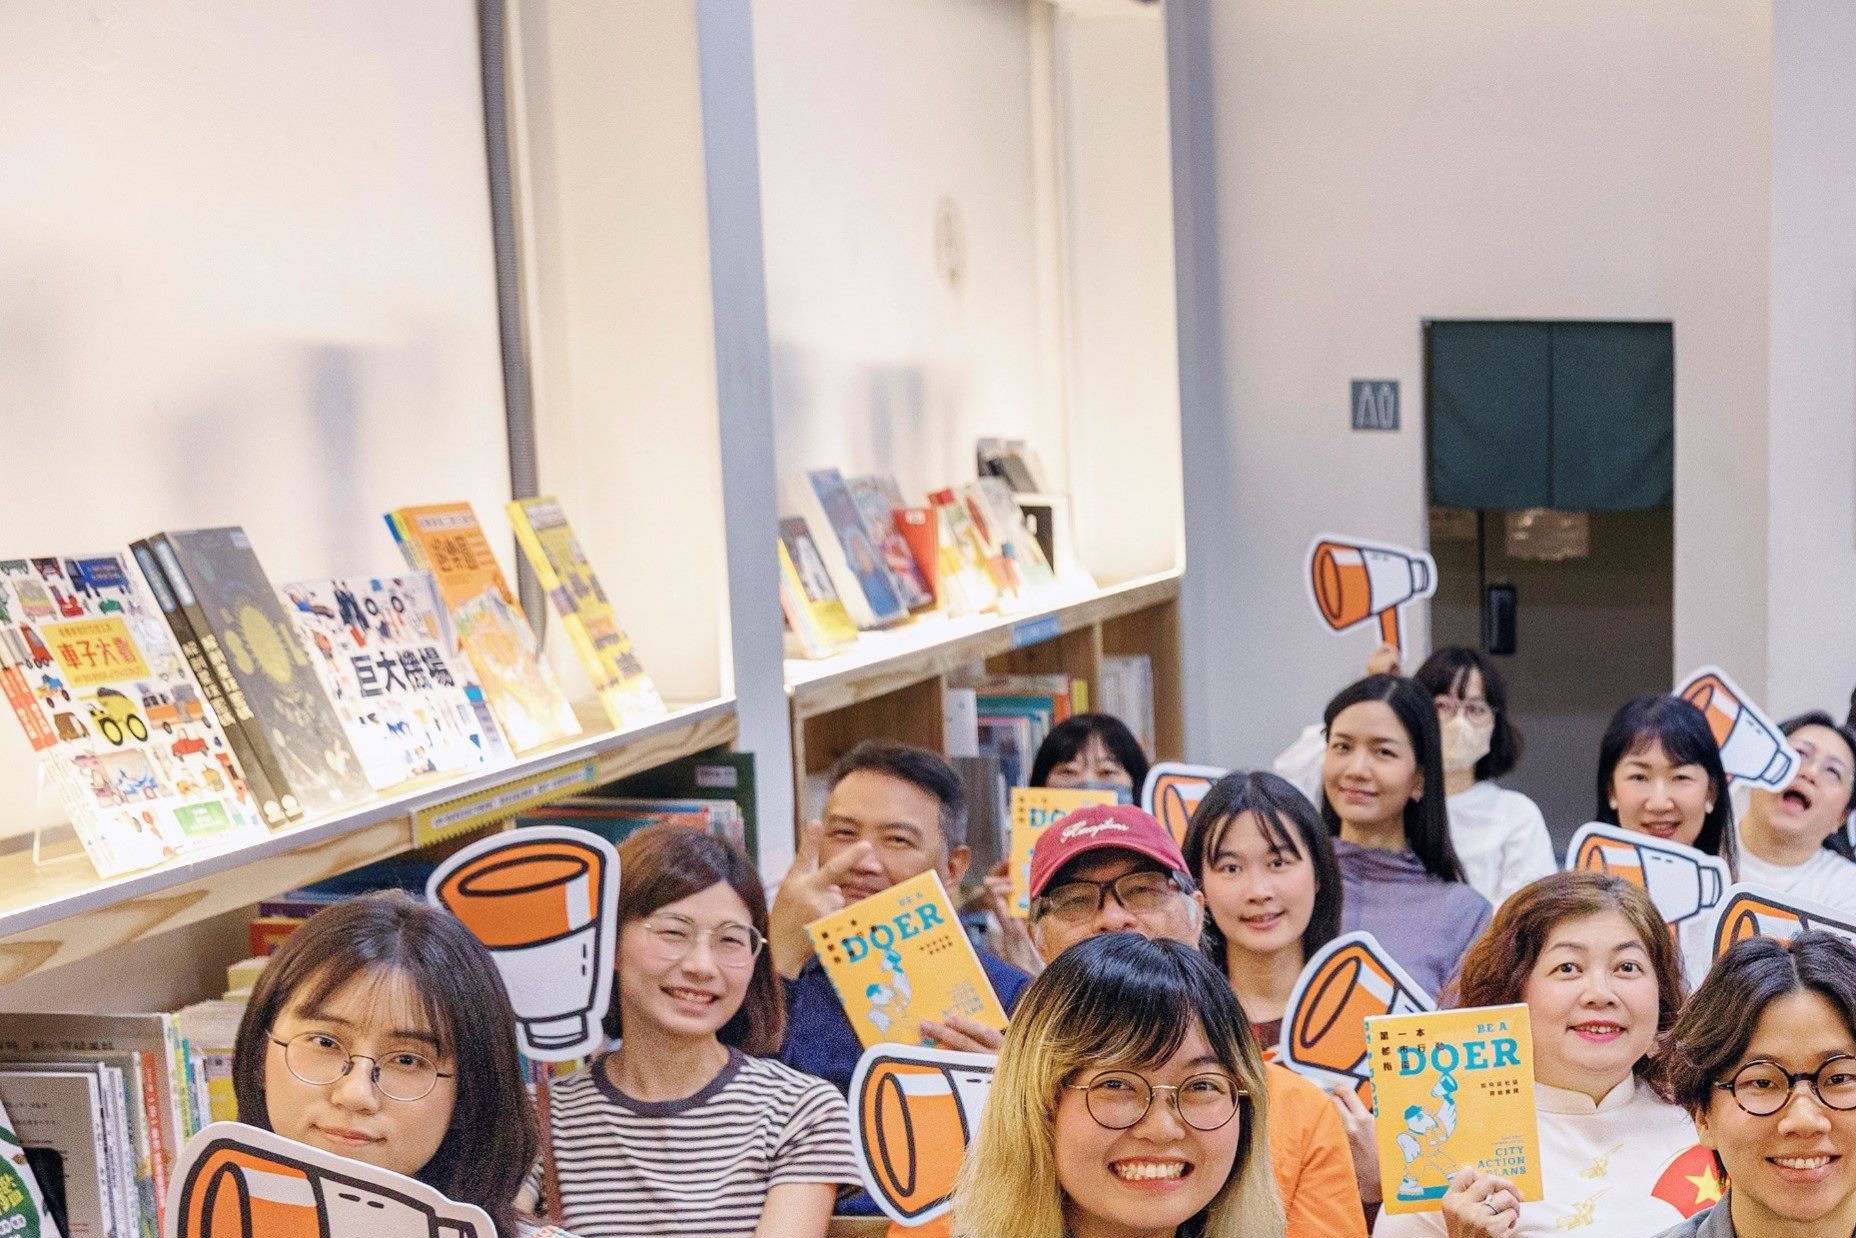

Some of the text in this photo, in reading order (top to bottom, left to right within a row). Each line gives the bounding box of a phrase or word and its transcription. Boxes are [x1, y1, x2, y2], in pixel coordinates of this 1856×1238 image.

[350, 646, 456, 698] 巨大機場
[841, 902, 945, 964] DOER
[1476, 1021, 1508, 1034] BE A
[1397, 1036, 1521, 1077] DOER
[1477, 1155, 1525, 1169] ACTION
[1495, 1145, 1524, 1157] CITY
